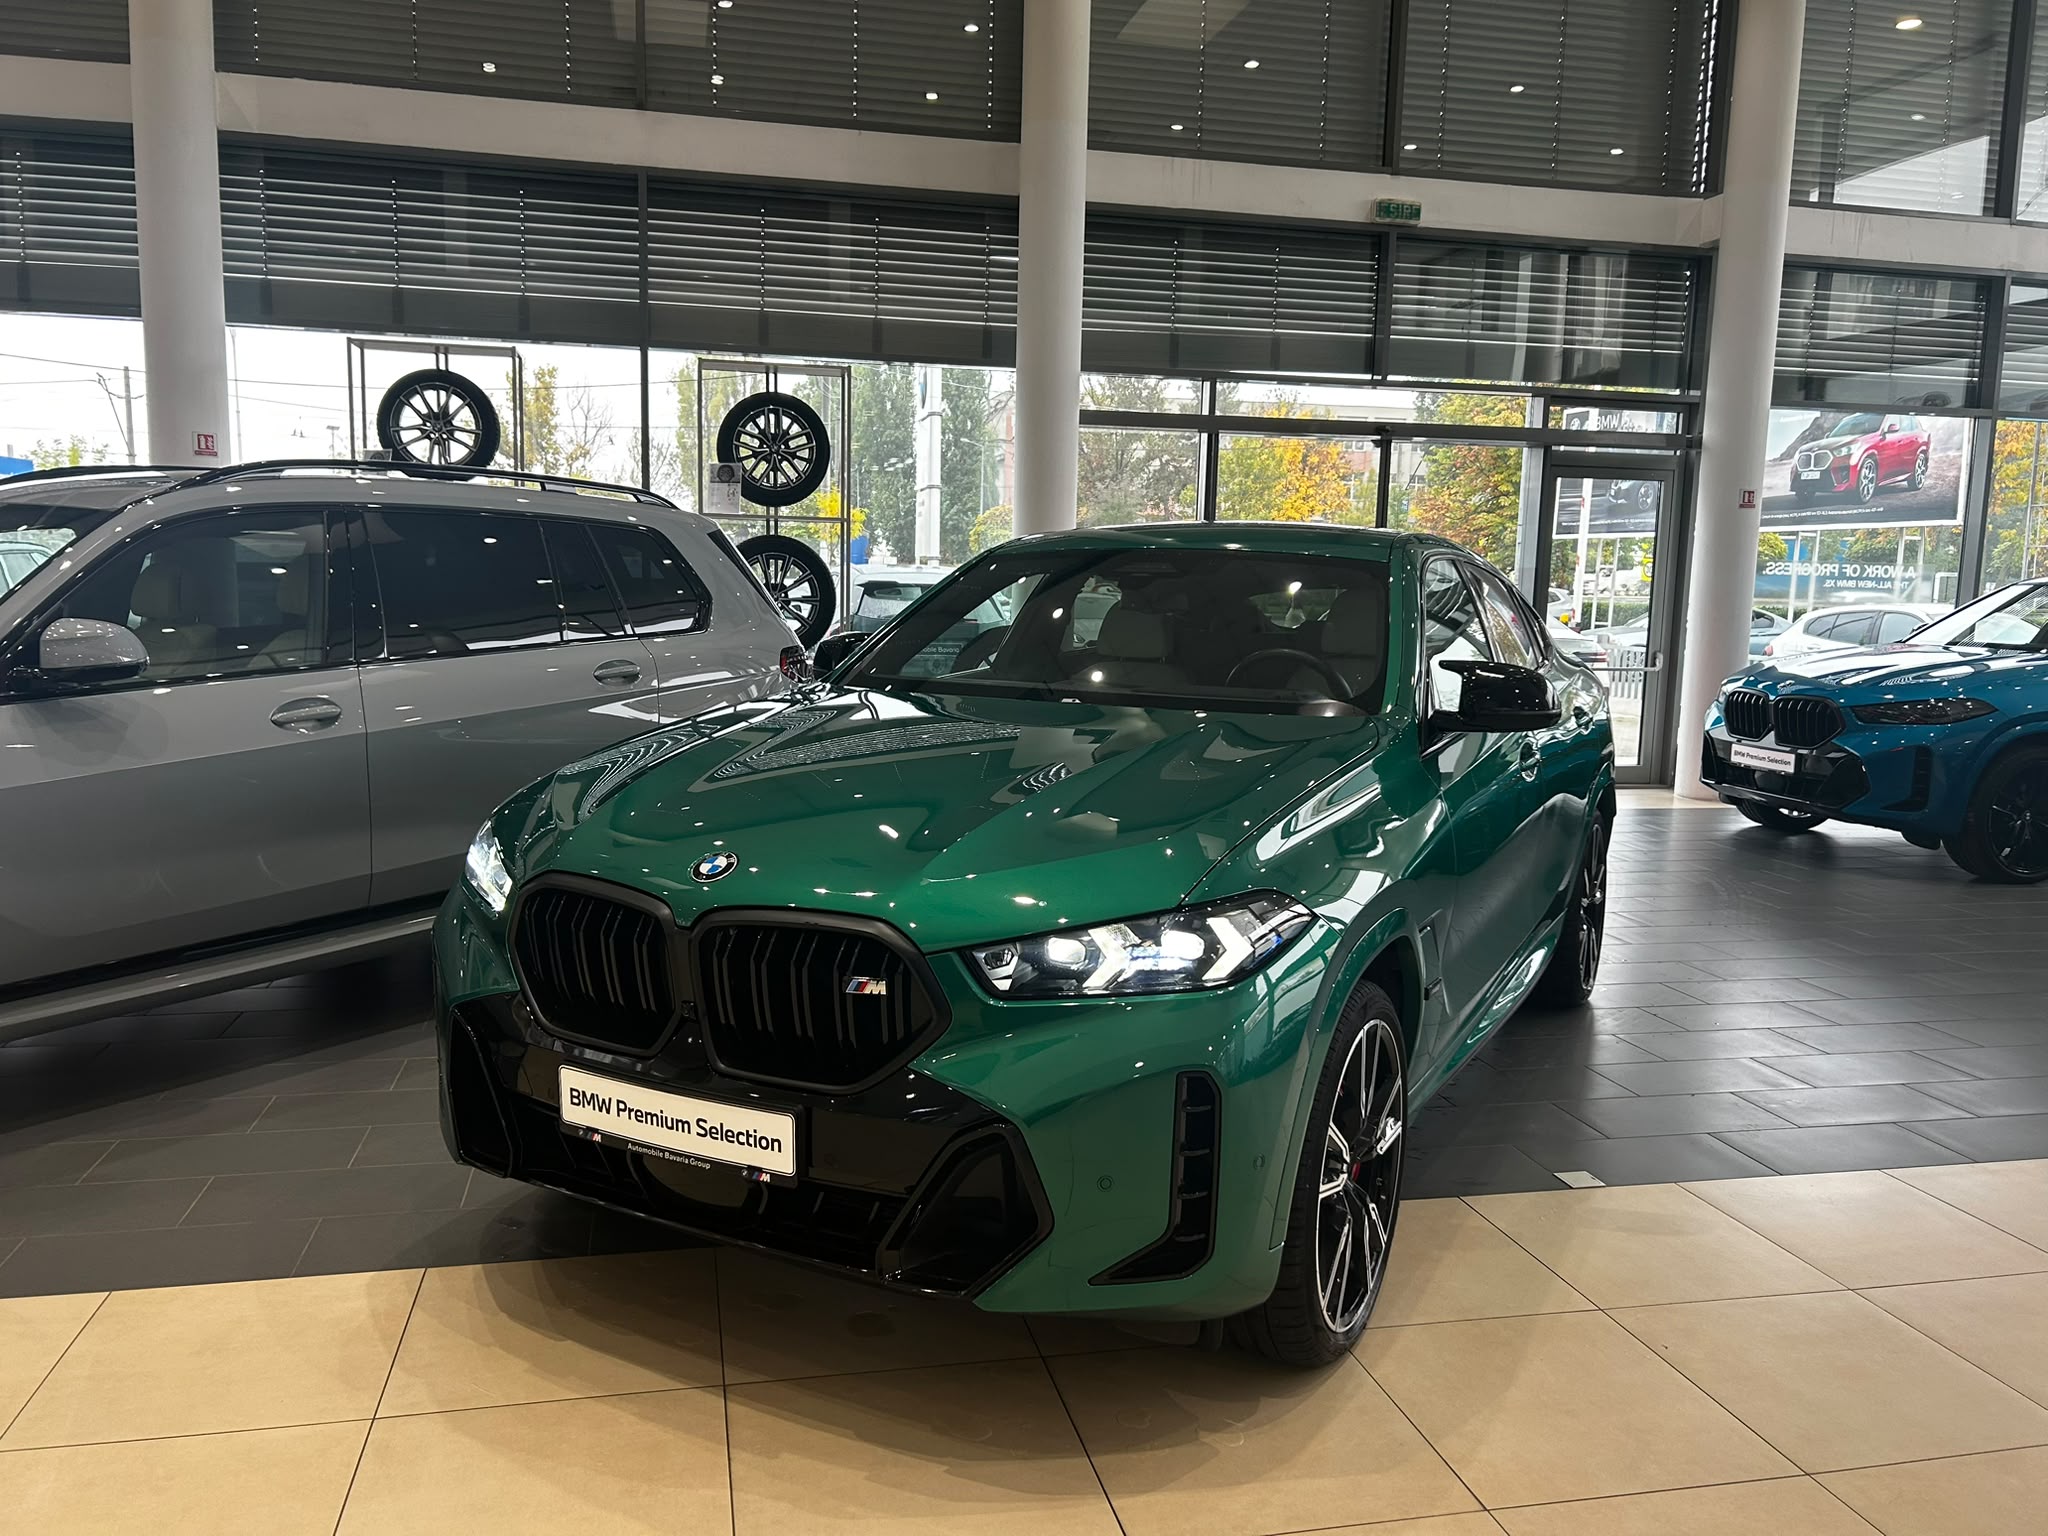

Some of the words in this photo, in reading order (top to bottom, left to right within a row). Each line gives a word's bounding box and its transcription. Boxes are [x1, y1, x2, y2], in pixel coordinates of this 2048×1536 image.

[1597, 412, 1620, 430] BMW
[1734, 749, 1746, 758] BMW
[1746, 752, 1767, 762] Premium
[1767, 755, 1792, 766] Selection
[569, 1087, 612, 1115] BMW
[616, 1098, 692, 1135] Premium
[696, 1117, 783, 1154] Selection
[627, 1142, 664, 1159] Automobile
[664, 1151, 689, 1165] Bavaria
[689, 1157, 711, 1170] Group
